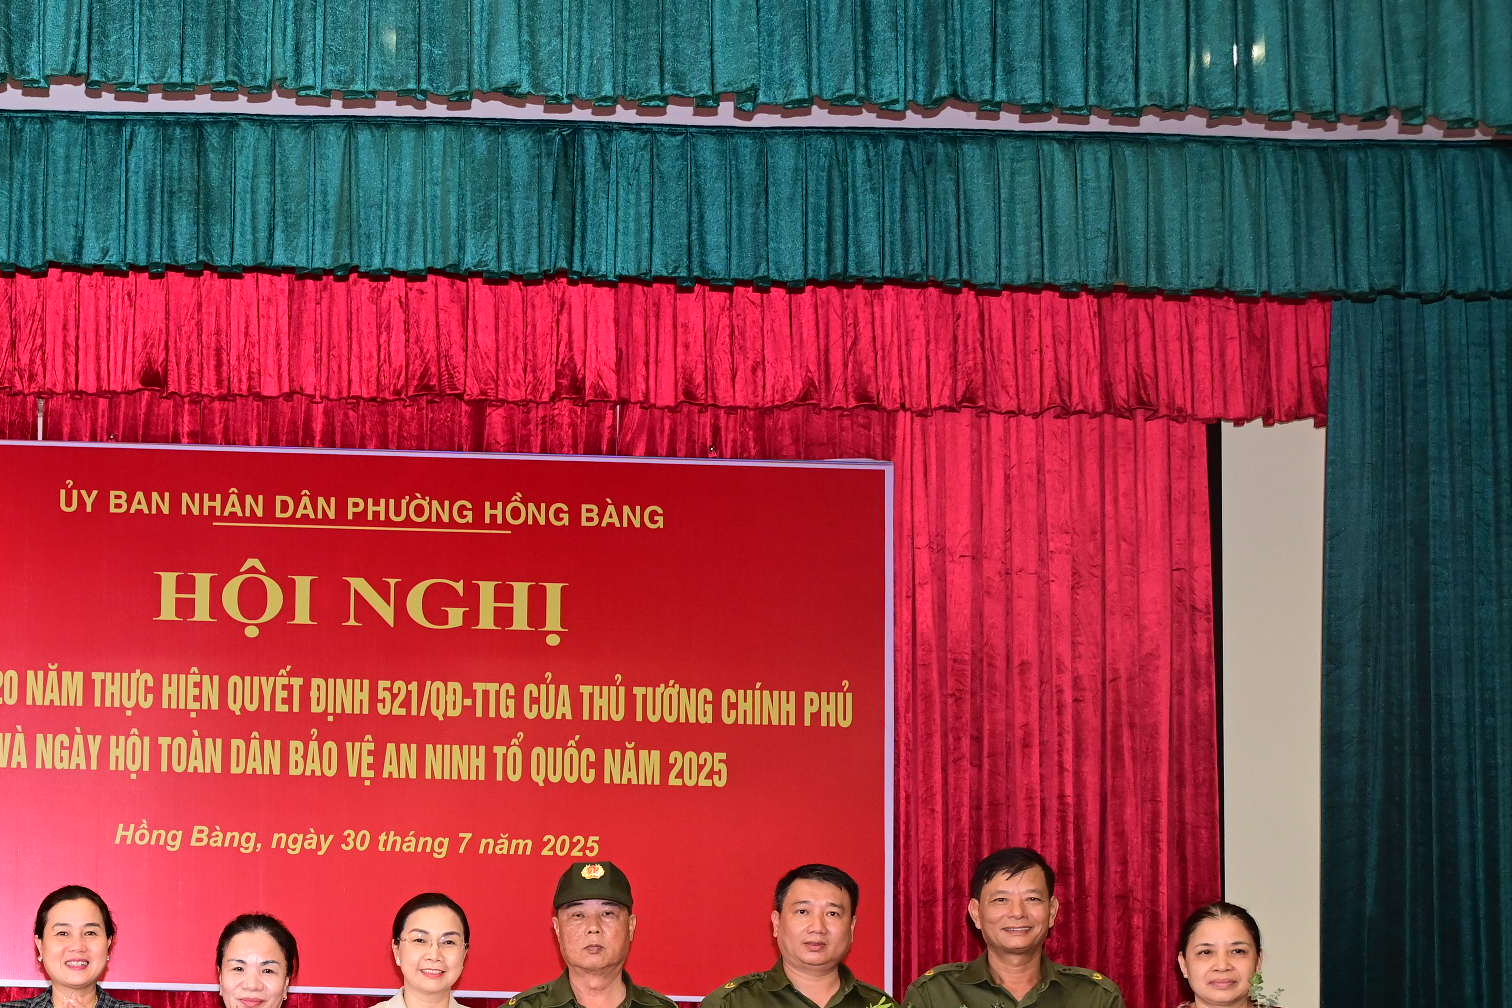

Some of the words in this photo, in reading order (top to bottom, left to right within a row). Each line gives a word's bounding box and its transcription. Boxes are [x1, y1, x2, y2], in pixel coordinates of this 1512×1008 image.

[59, 480, 100, 513] ỦY
[109, 490, 171, 515] BAN
[181, 488, 265, 518] NHÂN
[274, 489, 336, 520] DÂN
[346, 494, 473, 525] PHƯỜNG
[483, 492, 570, 526] HỒNG
[581, 498, 665, 529] BÀNG
[153, 558, 318, 638] HỘI
[341, 576, 568, 647] NGHỊ
[27, 664, 83, 705] NĂM
[92, 670, 153, 715] THỰC
[162, 668, 219, 718] HIỆN
[228, 666, 303, 715] QUYẾT
[310, 677, 370, 722] ĐỊNH
[377, 681, 514, 720] 521/QĐ-TTG
[523, 672, 573, 721] CỦA
[579, 674, 626, 722] THỦ
[633, 680, 712, 723] TƯỚNG
[722, 683, 795, 725] CHÍNH
[805, 680, 853, 728] PHỦ
[36, 727, 102, 771] NGÀY
[110, 729, 150, 779] HỘI
[158, 731, 222, 773] TOÀN
[231, 732, 280, 775] DÂN
[289, 728, 338, 777] BẢO
[346, 736, 374, 785] VỆ
[383, 744, 416, 779] AN
[426, 744, 485, 780] NINH
[493, 731, 524, 782] TỔ
[531, 735, 596, 786] QUỐC
[604, 744, 660, 784] NĂM
[669, 751, 727, 787] 2025
[115, 819, 184, 852] Hồng
[191, 825, 262, 853] Bàng,
[272, 829, 334, 855] ngày
[342, 830, 370, 851] 30
[379, 832, 449, 858] tháng
[459, 833, 472, 852] 7
[479, 834, 532, 855] năm
[542, 835, 600, 857] 2025
